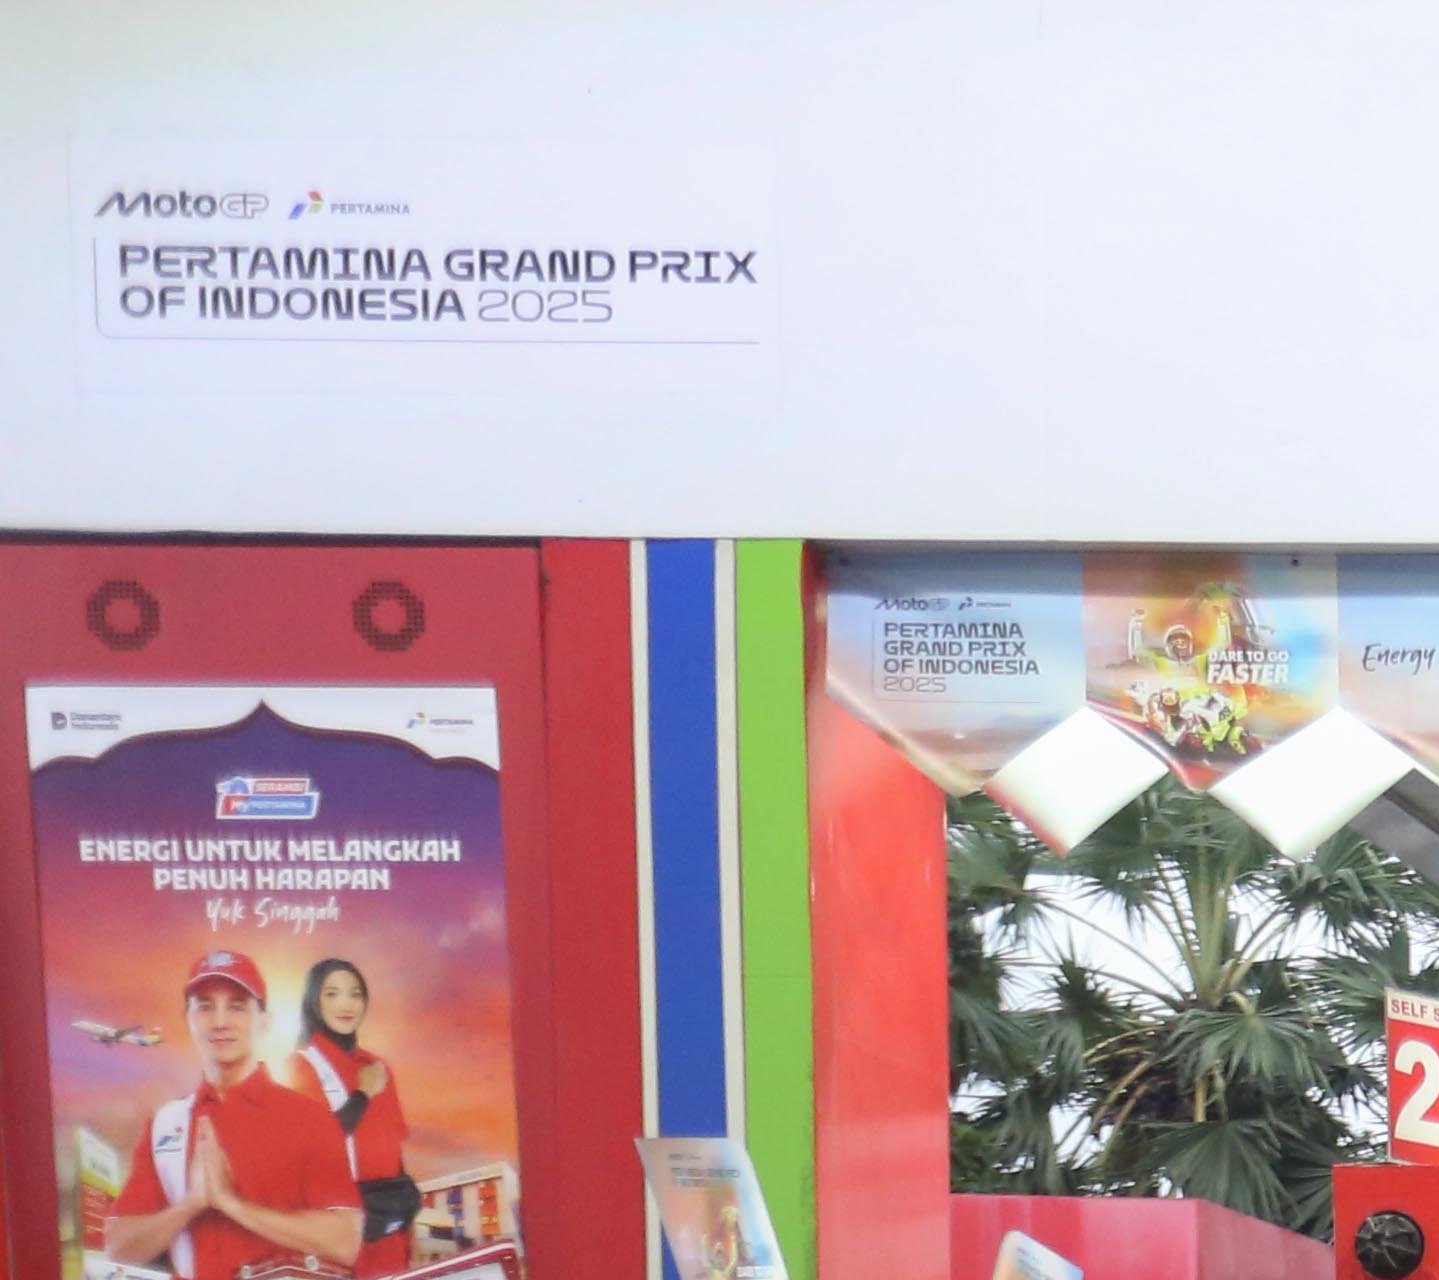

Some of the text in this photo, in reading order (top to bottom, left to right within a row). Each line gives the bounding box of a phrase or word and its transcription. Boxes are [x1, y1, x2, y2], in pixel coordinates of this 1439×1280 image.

[330, 202, 411, 215] PERTAMINA
[119, 245, 758, 284] PERTAMINA GRAND PRIX
[120, 286, 614, 324] OF INDONESIA 2025
[883, 621, 1024, 640] PERTAMINA
[883, 640, 1027, 658] GRAND PRIX
[1208, 650, 1242, 664] DARE
[1246, 650, 1266, 664] TO
[1362, 642, 1434, 676] Energy
[883, 658, 1040, 676] OF INDONESIA
[1206, 664, 1289, 685] FASTER
[883, 676, 947, 694] 2025
[80, 838, 461, 863] ENERGI UNTUK MELANGKAH
[153, 867, 390, 892] PENUH HARAPAN
[254, 897, 340, 934] Singgah
[1391, 998, 1428, 1023] SELF
